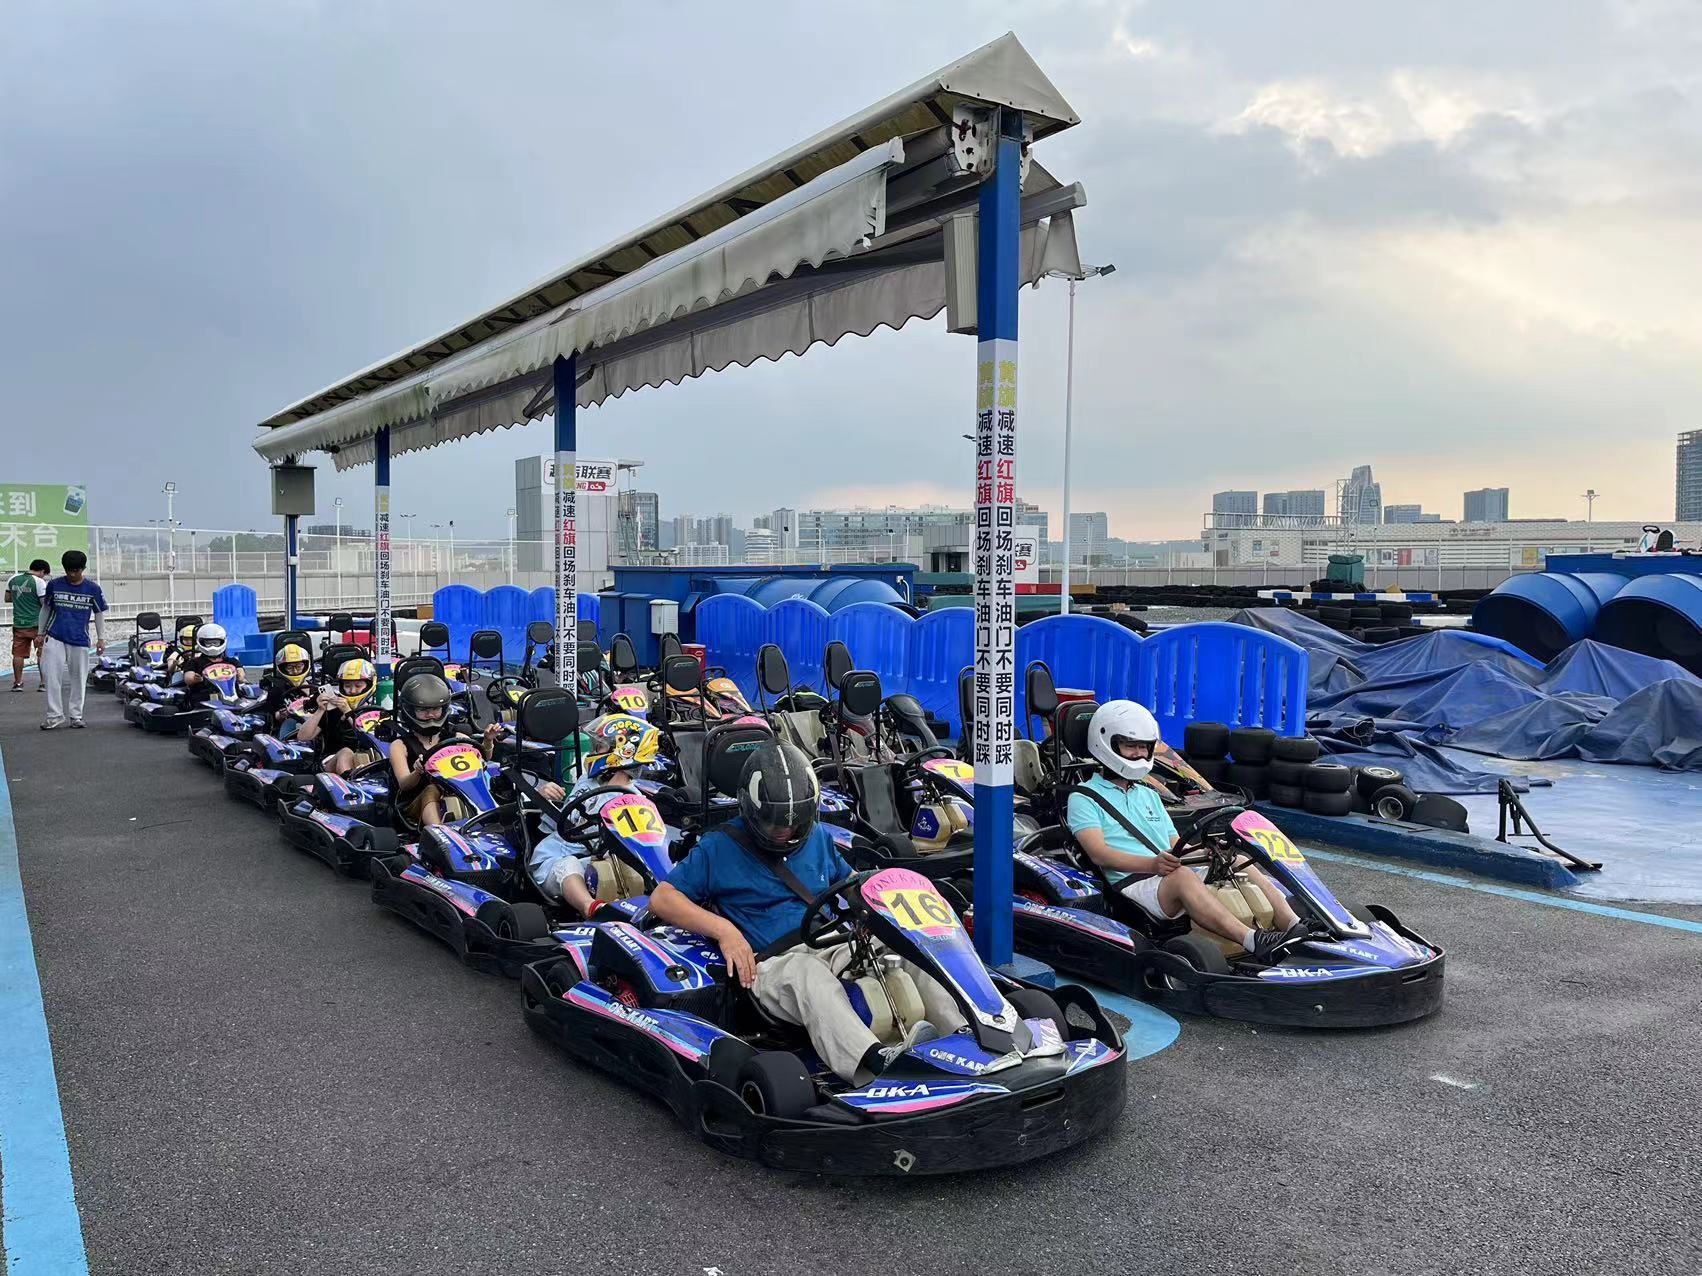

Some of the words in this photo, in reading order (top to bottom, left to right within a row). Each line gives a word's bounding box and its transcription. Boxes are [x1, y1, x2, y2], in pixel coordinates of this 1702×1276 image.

[70, 595, 91, 603] KART
[621, 696, 645, 708] 10
[450, 755, 471, 772] 6
[944, 765, 961, 778] 7
[616, 807, 662, 833] 12
[1254, 831, 1303, 859] 22
[890, 892, 953, 926] 16
[623, 935, 643, 952] KART
[626, 1010, 660, 1032] KART
[955, 1055, 987, 1074] KAR
